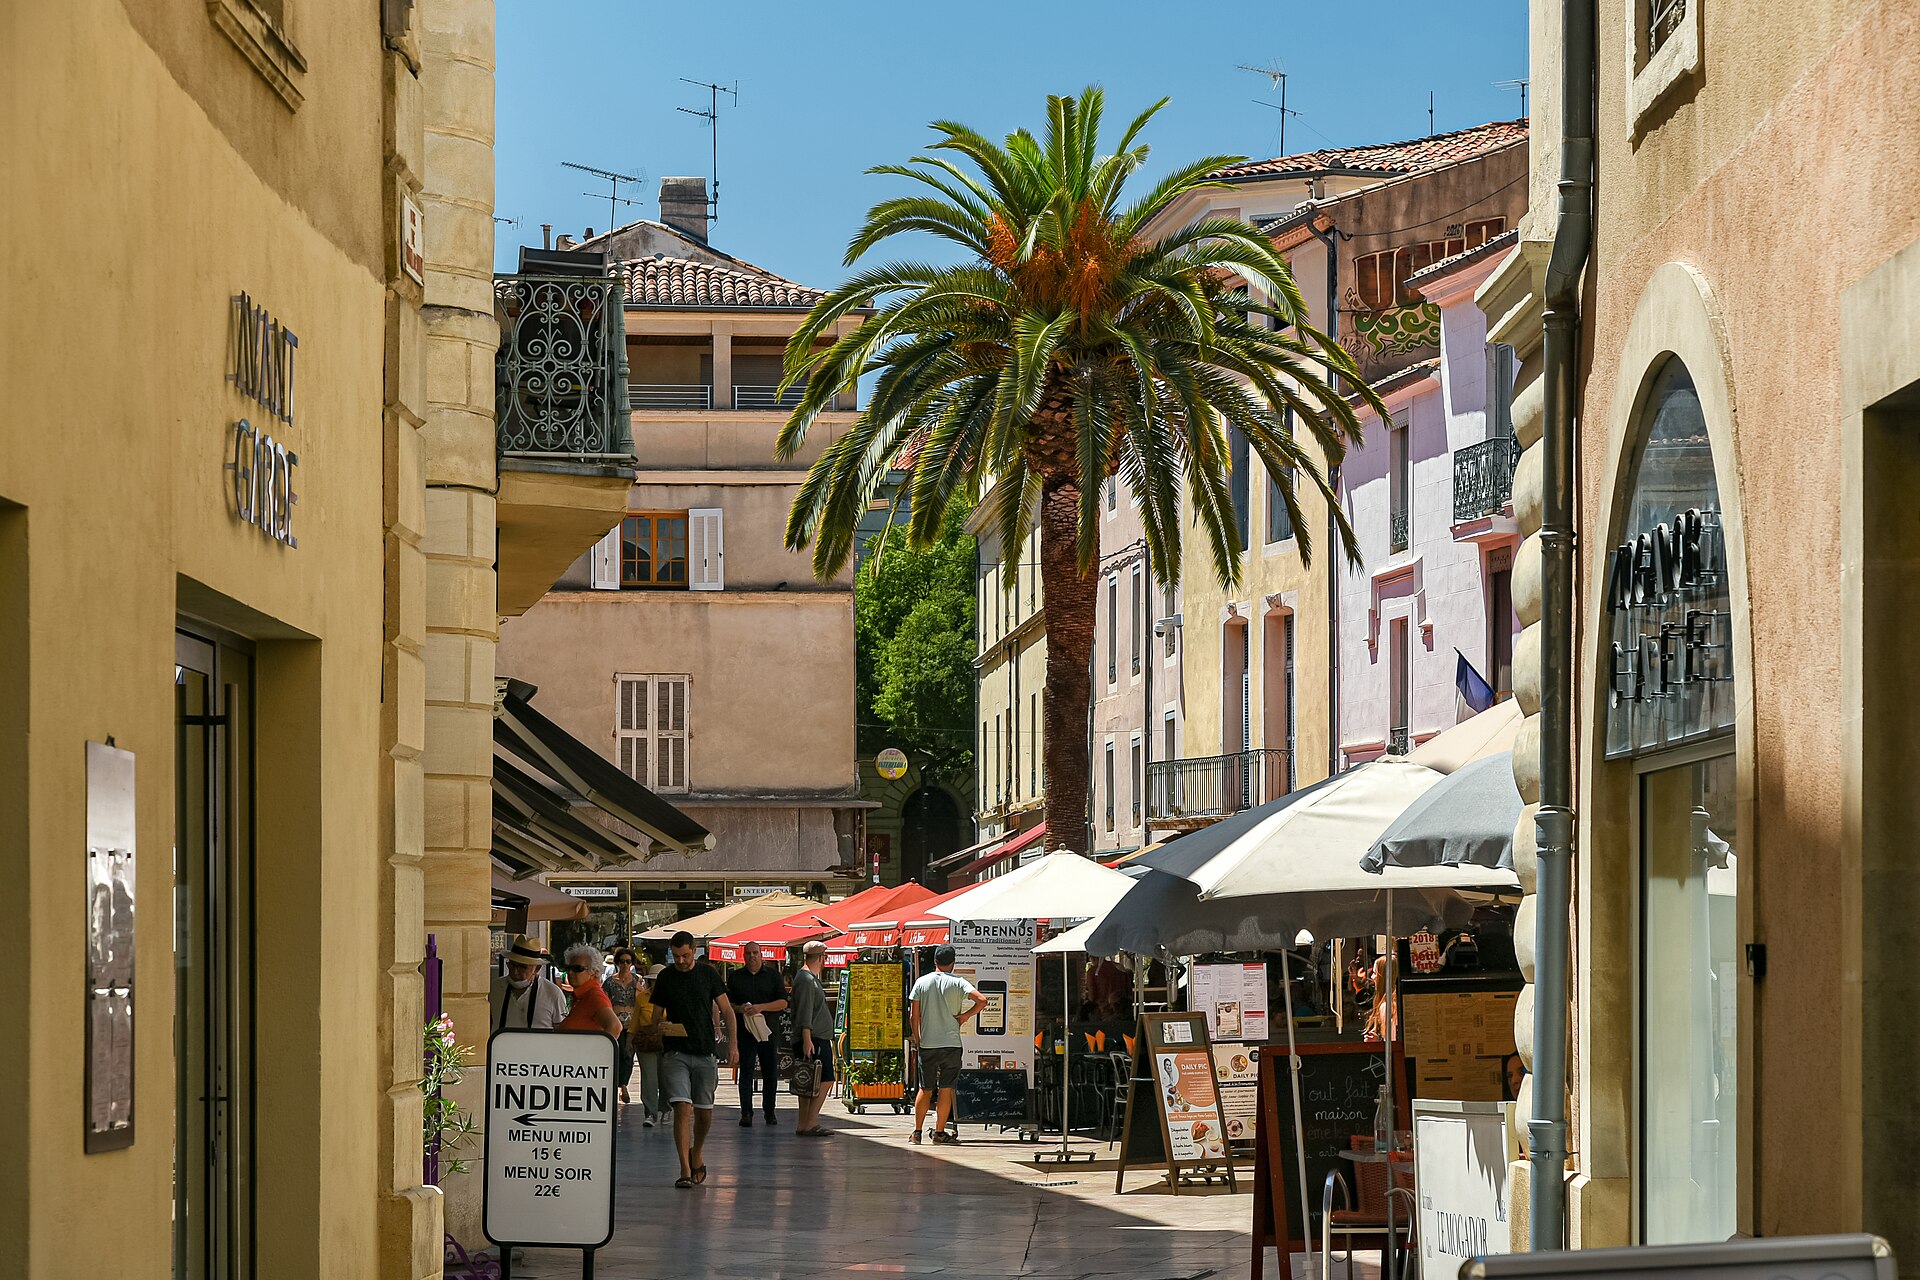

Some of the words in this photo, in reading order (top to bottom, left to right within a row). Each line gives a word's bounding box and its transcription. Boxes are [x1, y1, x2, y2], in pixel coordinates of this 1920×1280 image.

[236, 290, 298, 427] AVANT
[235, 418, 298, 549] GARDE
[954, 925, 968, 936] LE
[975, 926, 1033, 937] BRENNUS
[1413, 934, 1434, 943] 2018
[496, 1063, 608, 1079] RESTAURANT
[495, 1084, 607, 1112] INDIEN
[1315, 1107, 1368, 1121] maison
[508, 1129, 553, 1142] MENU
[558, 1131, 591, 1143] MIDI
[531, 1147, 549, 1160] 15
[553, 1148, 562, 1160] €
[504, 1166, 549, 1179] MENU
[554, 1168, 592, 1180] SOIR
[534, 1185, 561, 1197] 22€
